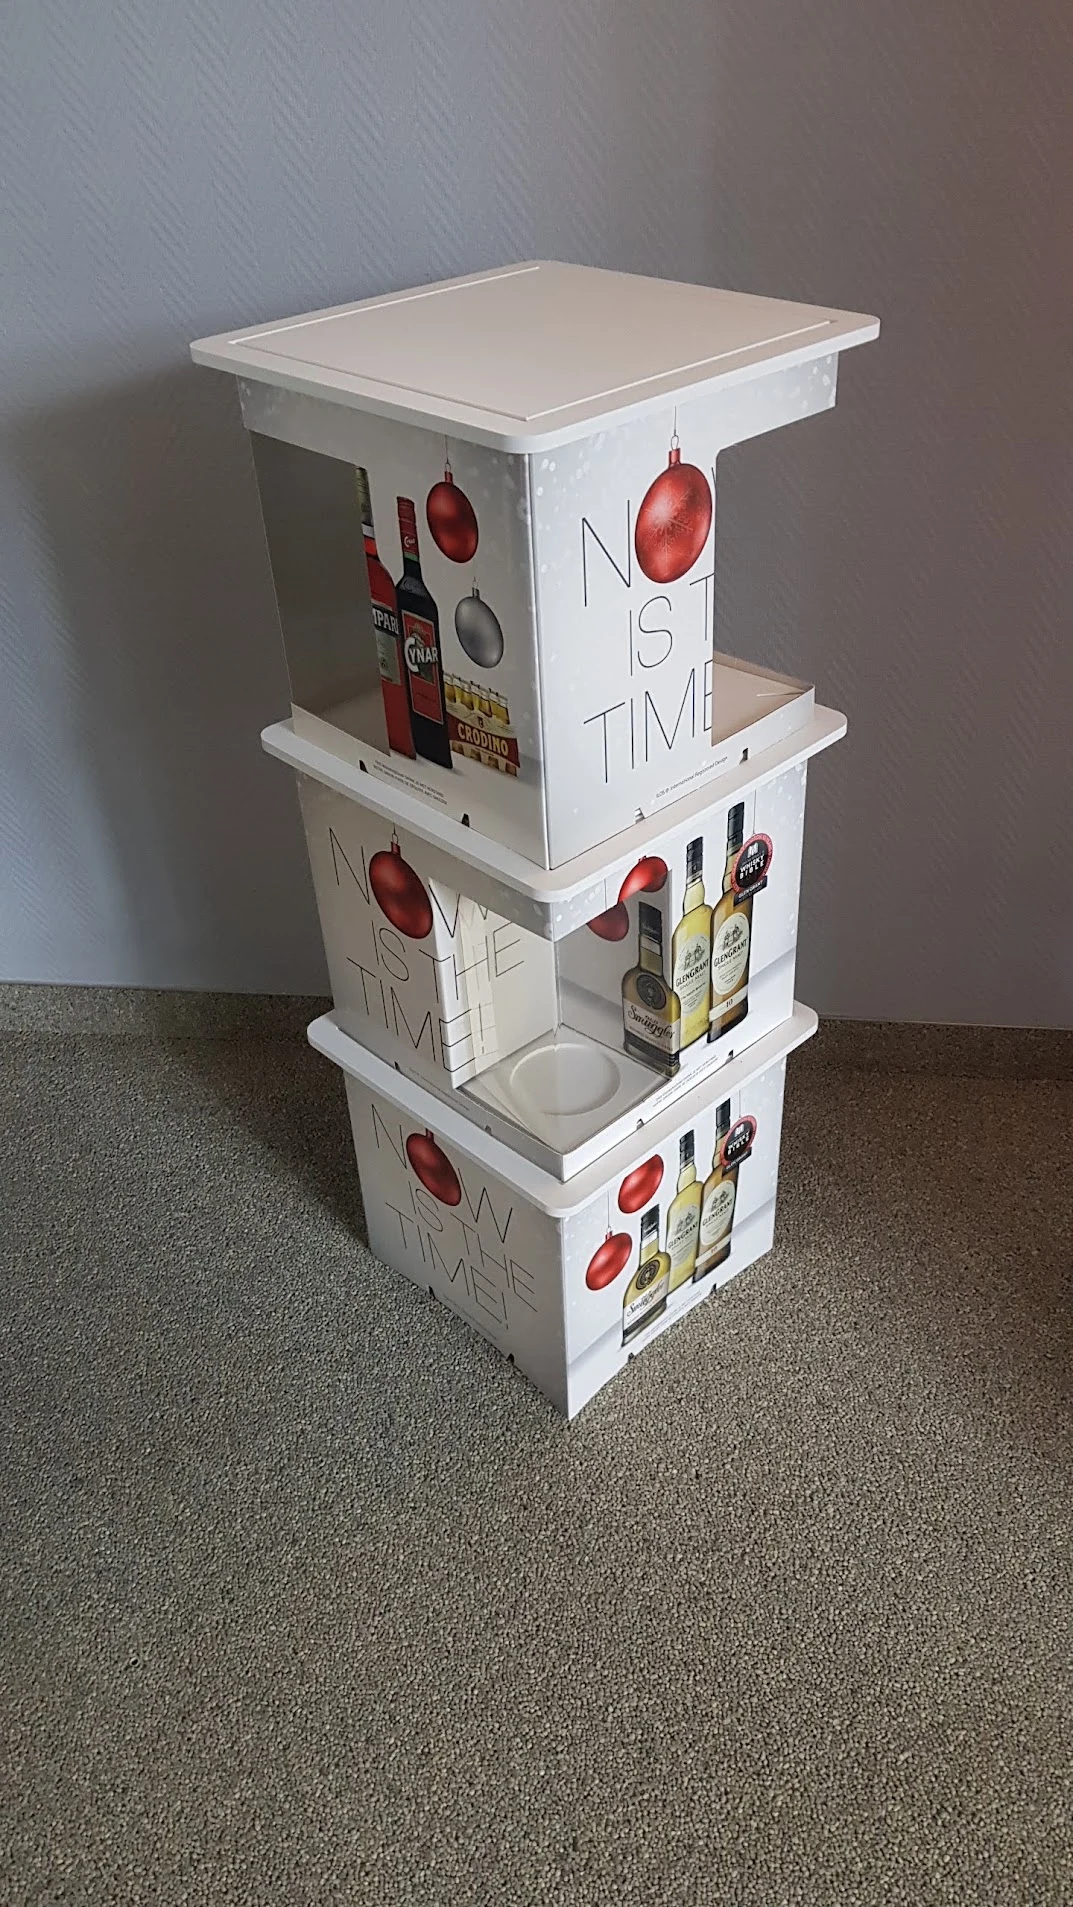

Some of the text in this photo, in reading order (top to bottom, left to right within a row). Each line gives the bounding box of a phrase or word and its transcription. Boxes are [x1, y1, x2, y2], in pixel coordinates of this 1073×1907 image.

[404, 636, 439, 673] CYNAR
[628, 595, 673, 677] IS
[457, 722, 509, 757] CRODINO
[371, 919, 524, 1004] IS THE
[675, 958, 709, 988] GLENGRANT
[713, 938, 748, 968] GLENGRANT
[371, 1103, 513, 1244] NOW
[408, 1180, 538, 1313] IS THE
